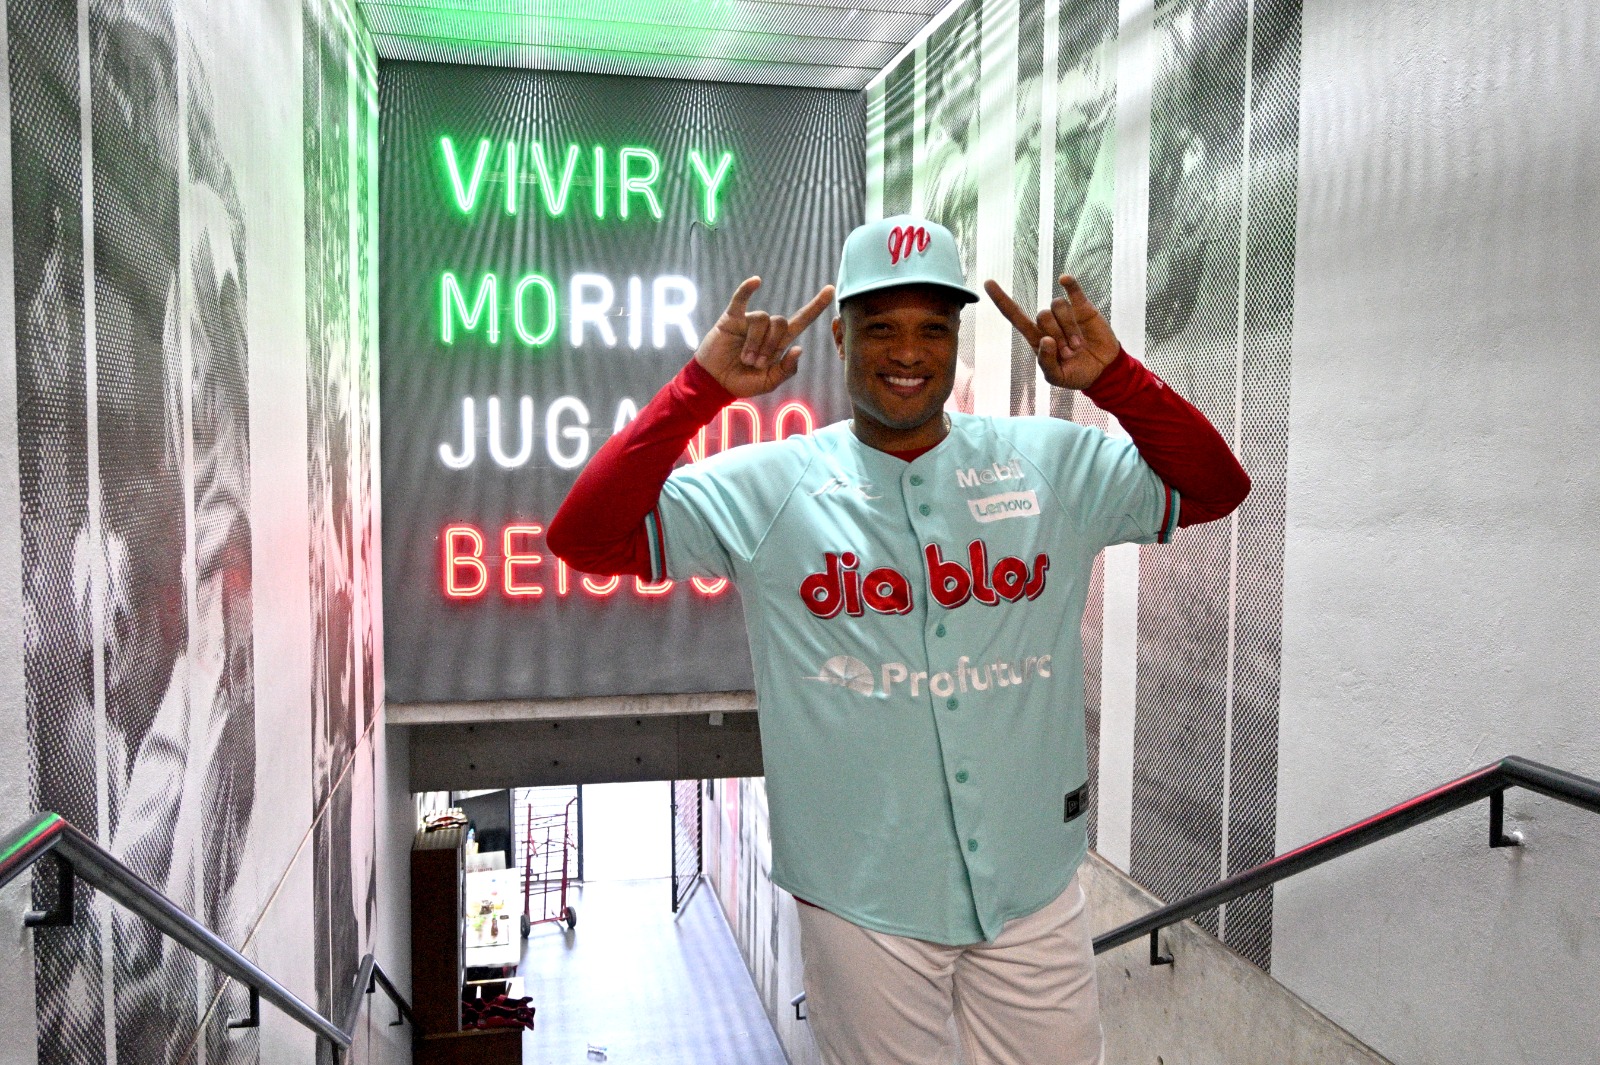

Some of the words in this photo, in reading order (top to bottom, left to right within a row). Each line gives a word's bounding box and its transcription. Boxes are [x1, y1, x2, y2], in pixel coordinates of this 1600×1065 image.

[440, 136, 663, 220] VIVIR
[690, 150, 733, 224] Y
[441, 272, 699, 349] MORIR
[956, 459, 1024, 488] Mobil
[975, 499, 1032, 517] Lenovo
[799, 539, 1050, 619] diablos
